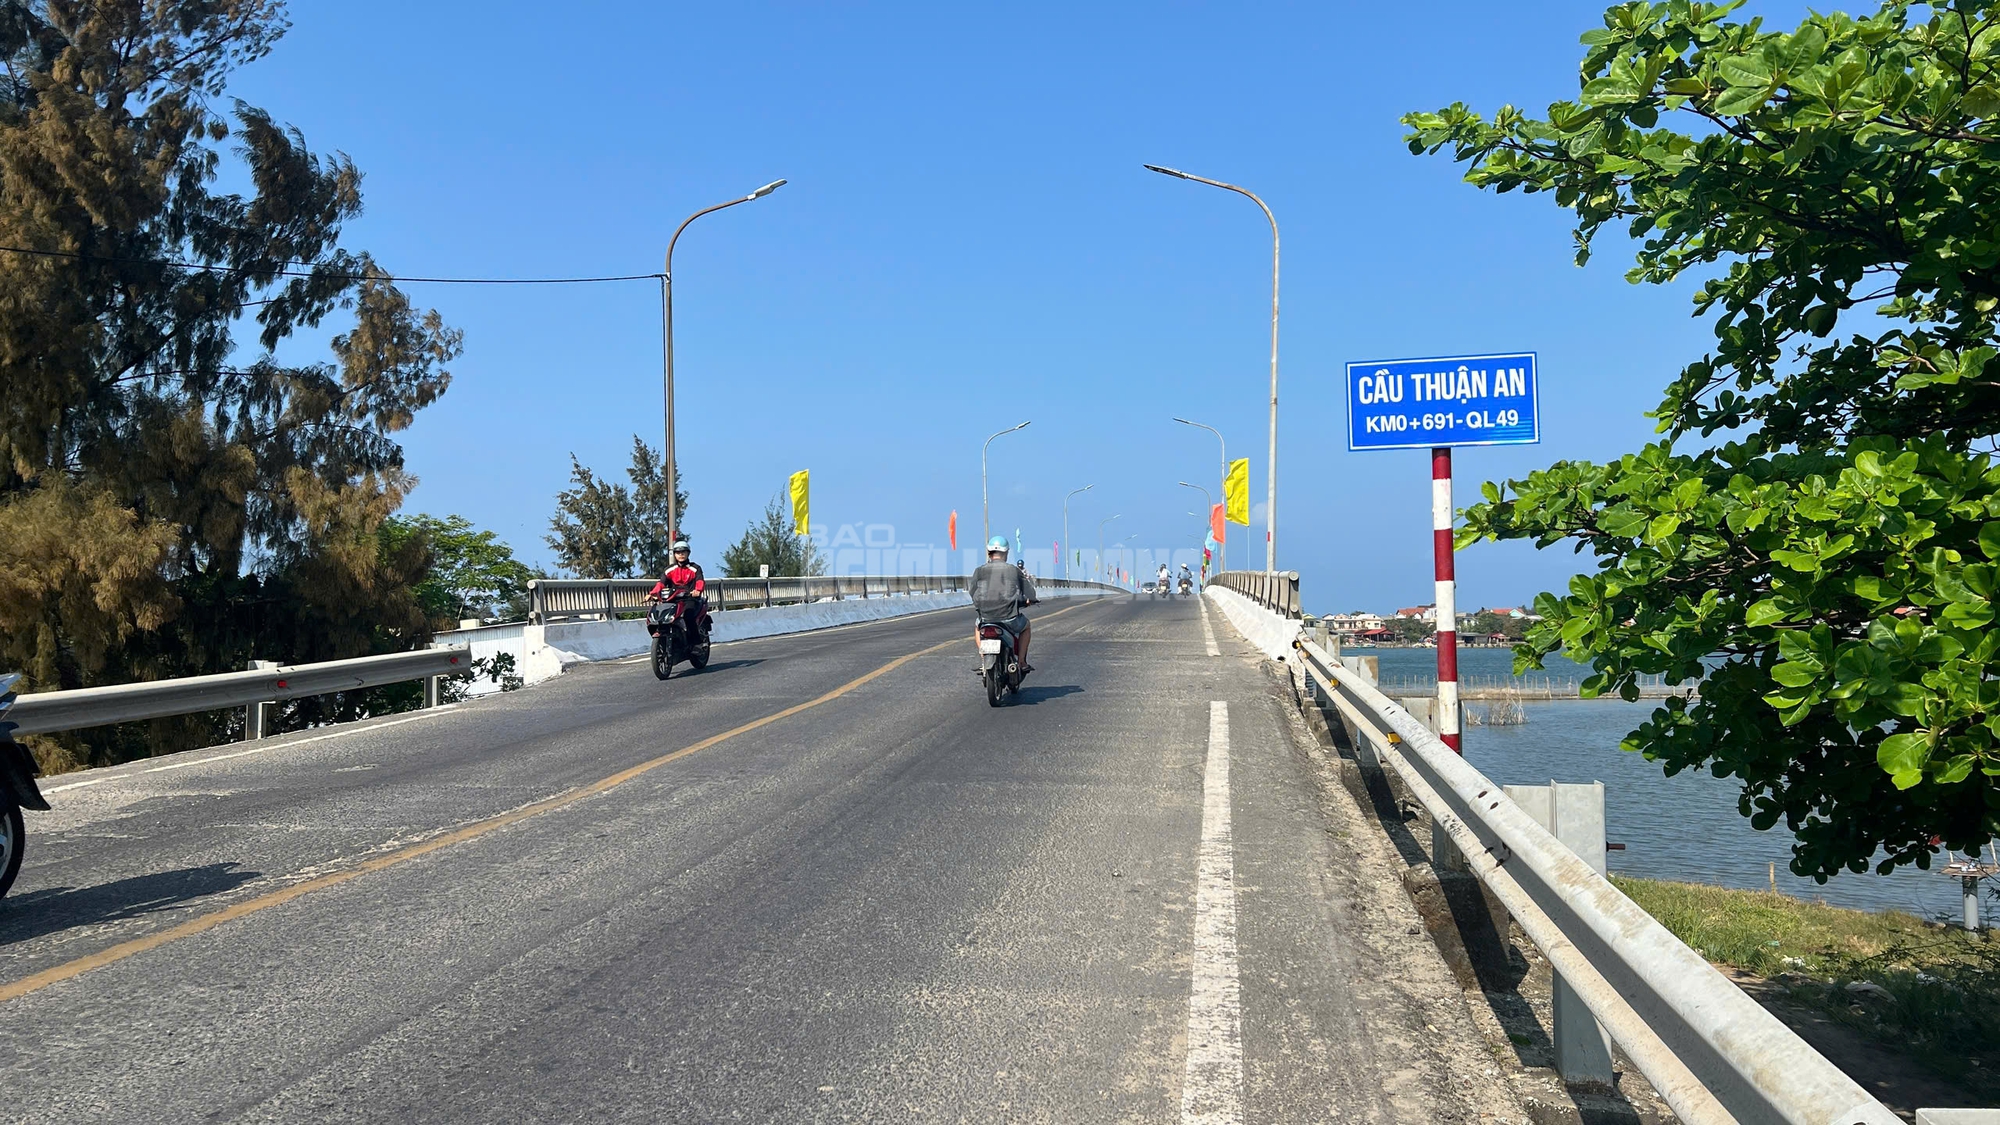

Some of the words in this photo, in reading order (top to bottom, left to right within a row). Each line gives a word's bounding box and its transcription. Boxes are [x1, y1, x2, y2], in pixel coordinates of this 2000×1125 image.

[1358, 368, 1404, 405] CẦU
[1410, 365, 1488, 404] THUẬN
[1493, 368, 1526, 398] AN
